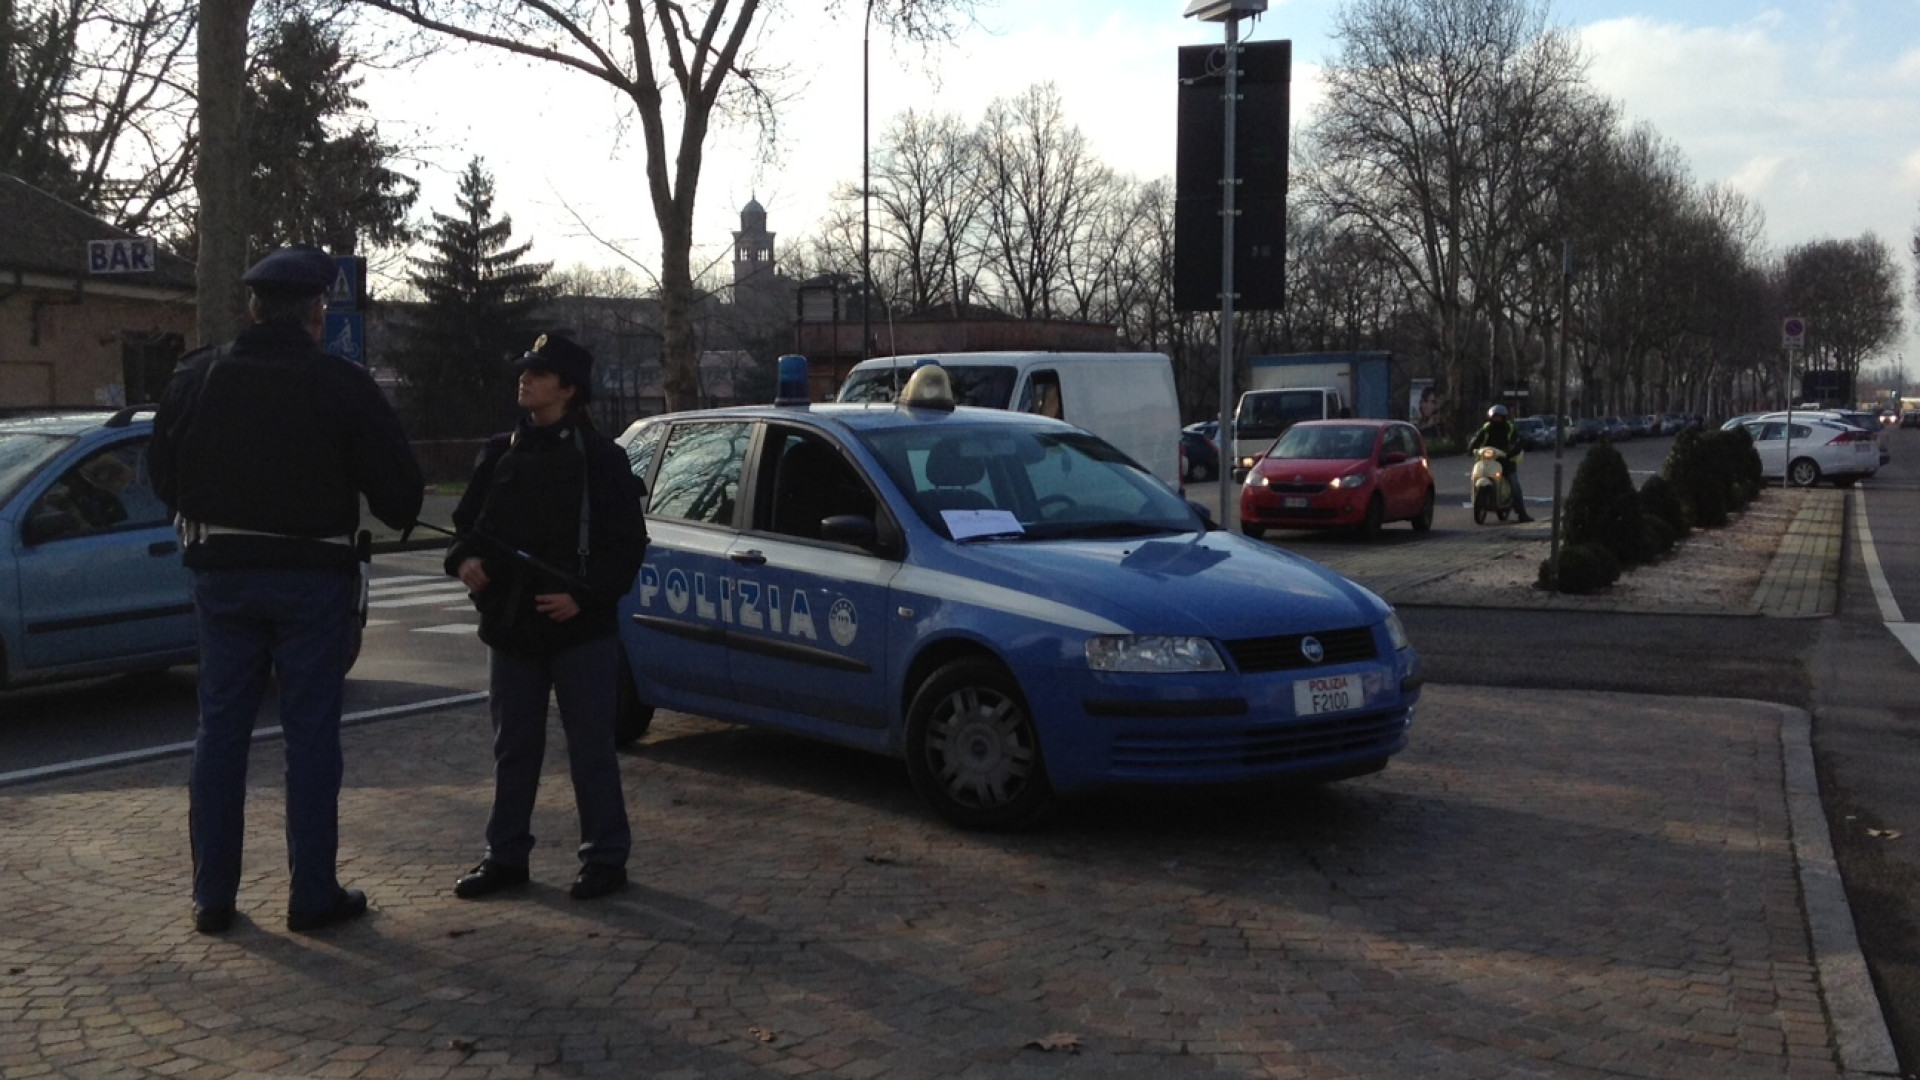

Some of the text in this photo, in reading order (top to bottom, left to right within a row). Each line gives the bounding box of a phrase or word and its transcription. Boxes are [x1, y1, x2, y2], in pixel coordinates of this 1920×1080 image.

[91, 242, 150, 270] BAR
[639, 563, 818, 640] POLIZIA
[1309, 676, 1348, 692] POLIZIA
[1313, 691, 1349, 713] F2100
